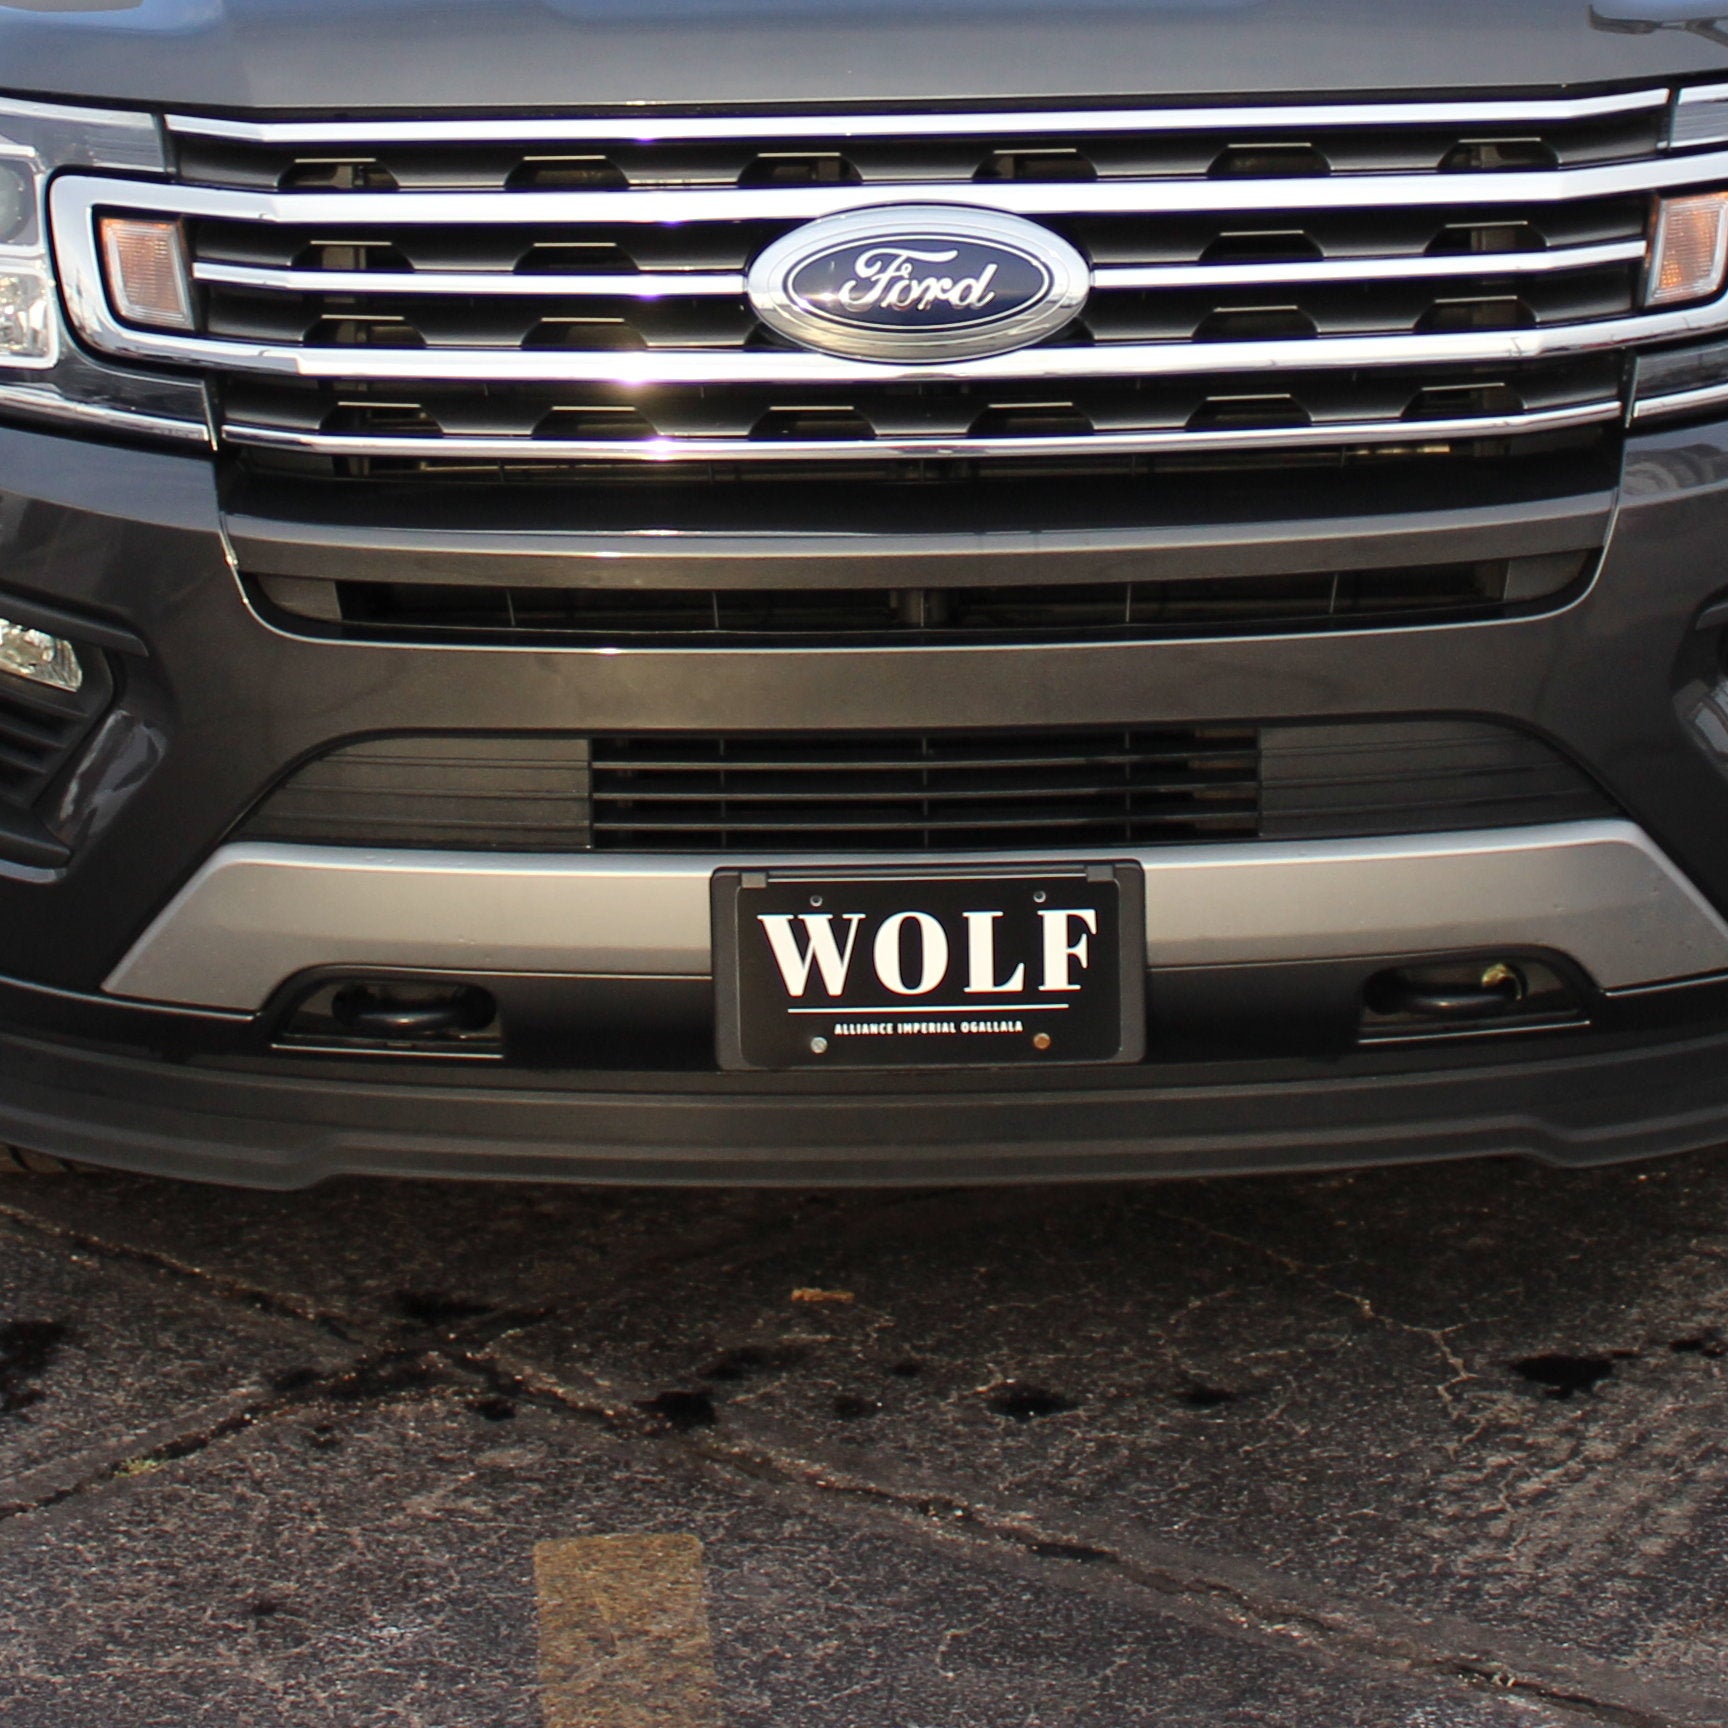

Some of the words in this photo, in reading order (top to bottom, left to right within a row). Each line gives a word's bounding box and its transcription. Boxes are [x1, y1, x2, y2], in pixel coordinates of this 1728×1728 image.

[838, 247, 999, 312] Ford
[756, 908, 1098, 997] WOLF
[834, 1022, 894, 1035] ALLIANCE
[897, 1021, 957, 1034] IMPERIAL
[959, 1020, 1023, 1033] OGALLALA
